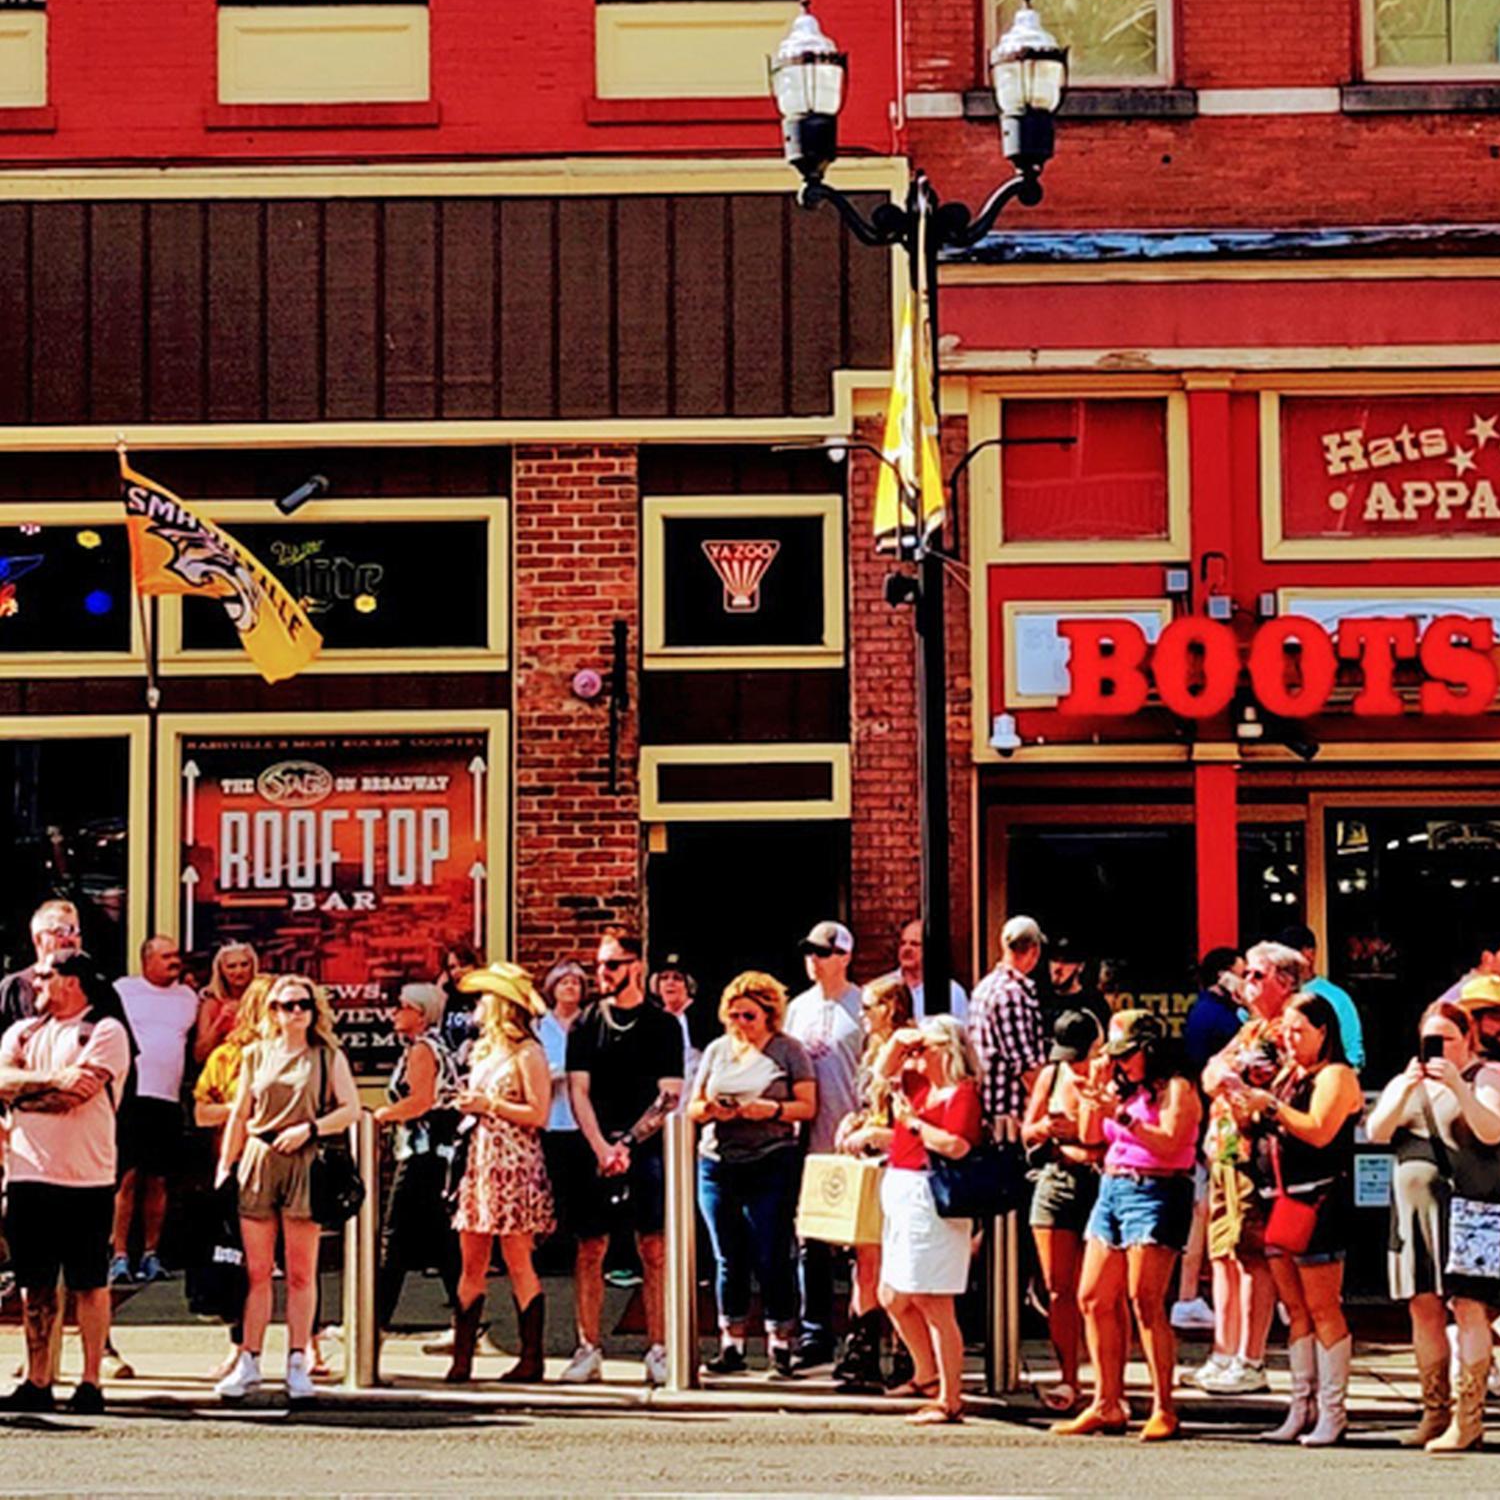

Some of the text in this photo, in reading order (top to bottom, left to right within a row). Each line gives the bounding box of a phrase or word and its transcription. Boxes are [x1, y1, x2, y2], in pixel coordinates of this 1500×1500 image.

[1321, 426, 1450, 477] Hats
[708, 544, 774, 560] YAZOO
[1056, 613, 1500, 719] BOOTS
[220, 778, 255, 794] THE
[361, 775, 450, 792] BROADWAY
[219, 807, 450, 889] ROOFTOP
[291, 891, 377, 912] BAR
